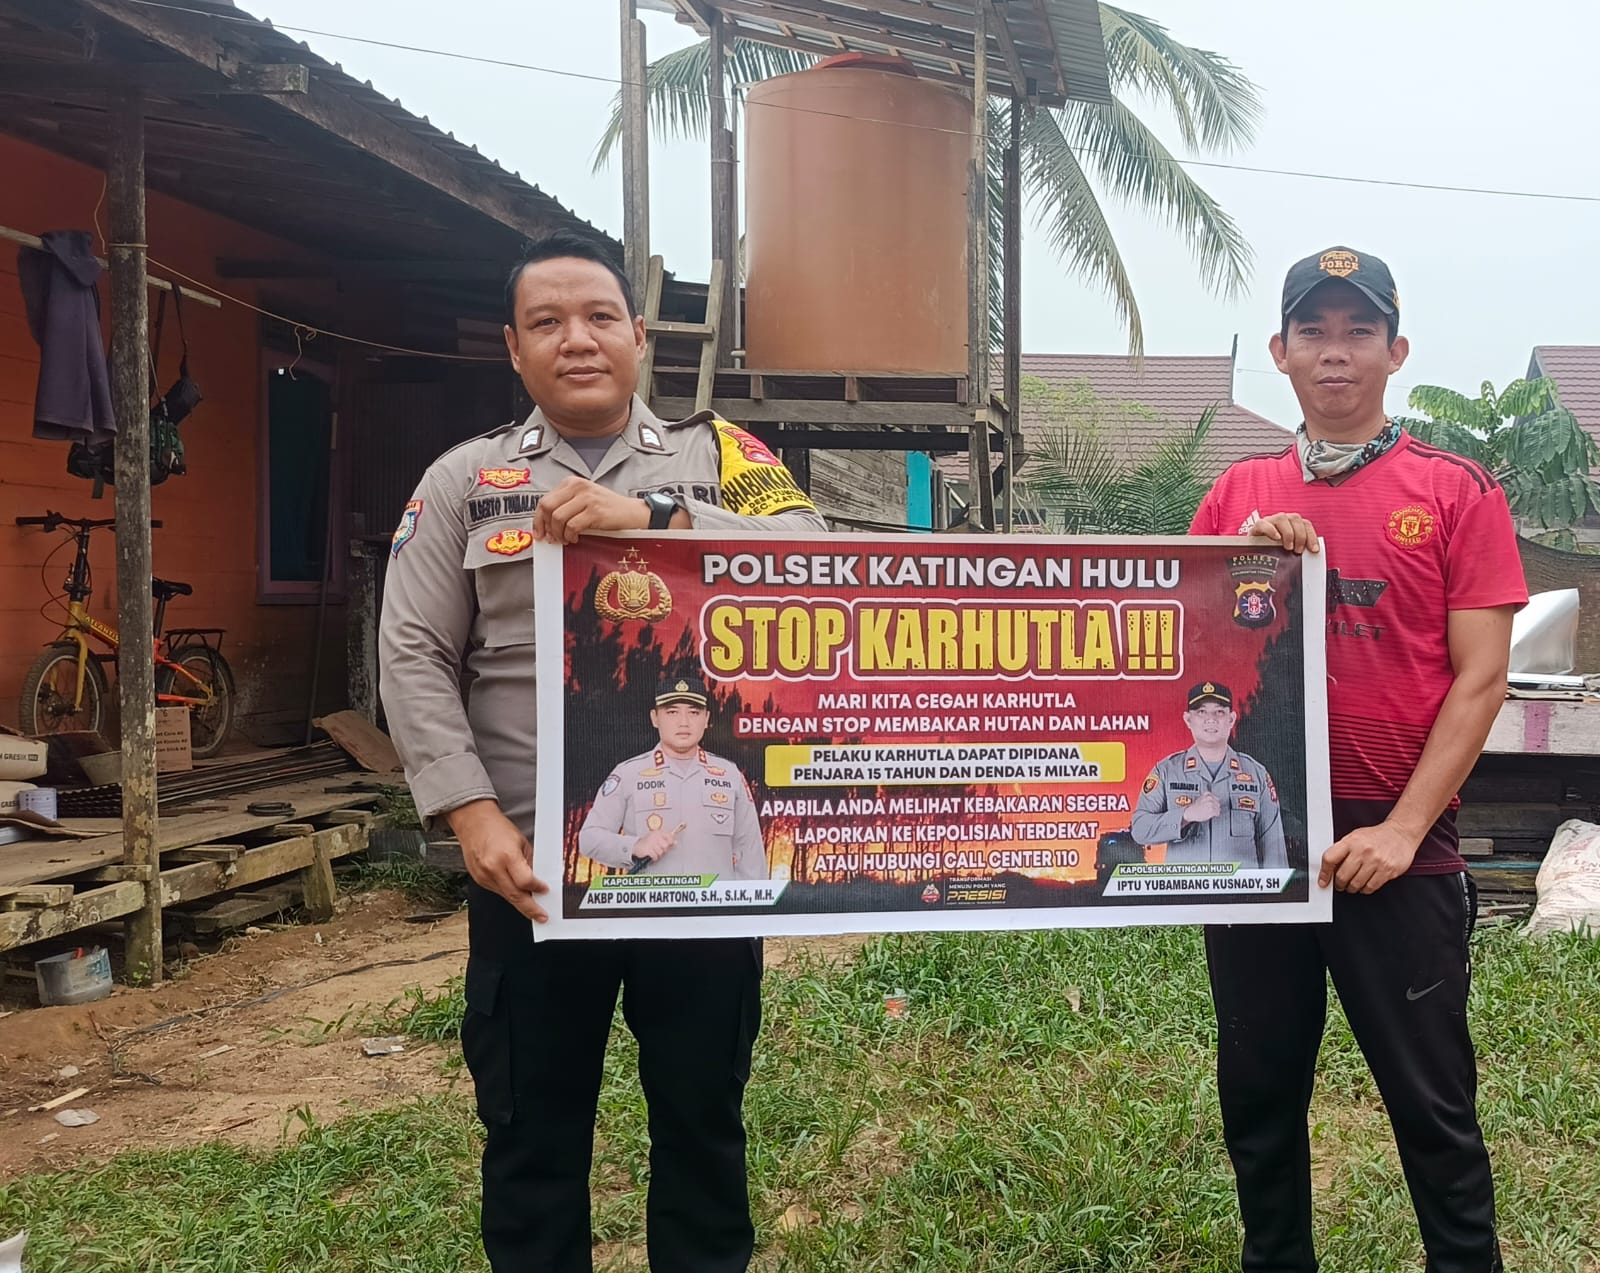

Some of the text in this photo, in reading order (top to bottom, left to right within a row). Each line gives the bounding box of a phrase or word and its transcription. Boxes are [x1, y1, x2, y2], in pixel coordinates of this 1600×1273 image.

[1319, 260, 1359, 271] FORCE
[1394, 533, 1422, 544] UNITED
[1232, 554, 1273, 563] POLRES
[704, 554, 1180, 588] POLSEK KATINGAN HULU
[709, 605, 1175, 671] STOP KARHUTLA !!!
[818, 692, 1077, 709] MARI KITA CEGAH KARHUTLA
[738, 714, 1149, 734] DENGAN STOP MEMBAKAR HUTAN DAN LAHAN
[813, 747, 1080, 762] PELAKU KARHUTLA DAPAT DIPIDANA
[794, 765, 1099, 780] PENJARA 15 TAHUN DAN DENDA 15 MILYAR
[637, 780, 666, 790] DODIK
[704, 778, 732, 789] POLRI
[1231, 783, 1258, 793] POLRI
[760, 795, 1130, 817] APABILA ANDA MELIHAT KEBAKARAN SEGERA
[795, 823, 1098, 844] LAPORKAN KE KEPOLISIAN TERDEKAT
[814, 850, 1079, 871] ATAU HUBUNGI CALL CENTER 110
[1119, 865, 1233, 875] KAPOLSEK KATINGAN HULU
[603, 876, 700, 886] KAPOLRES KATINGAN
[1117, 878, 1280, 891] IPTU YUBAMBANG KUSNADY, SH
[587, 889, 775, 905] AKBP DODIK HARTONO, S.H., S.I.K., M.H.
[946, 889, 1007, 901] PRESISI
